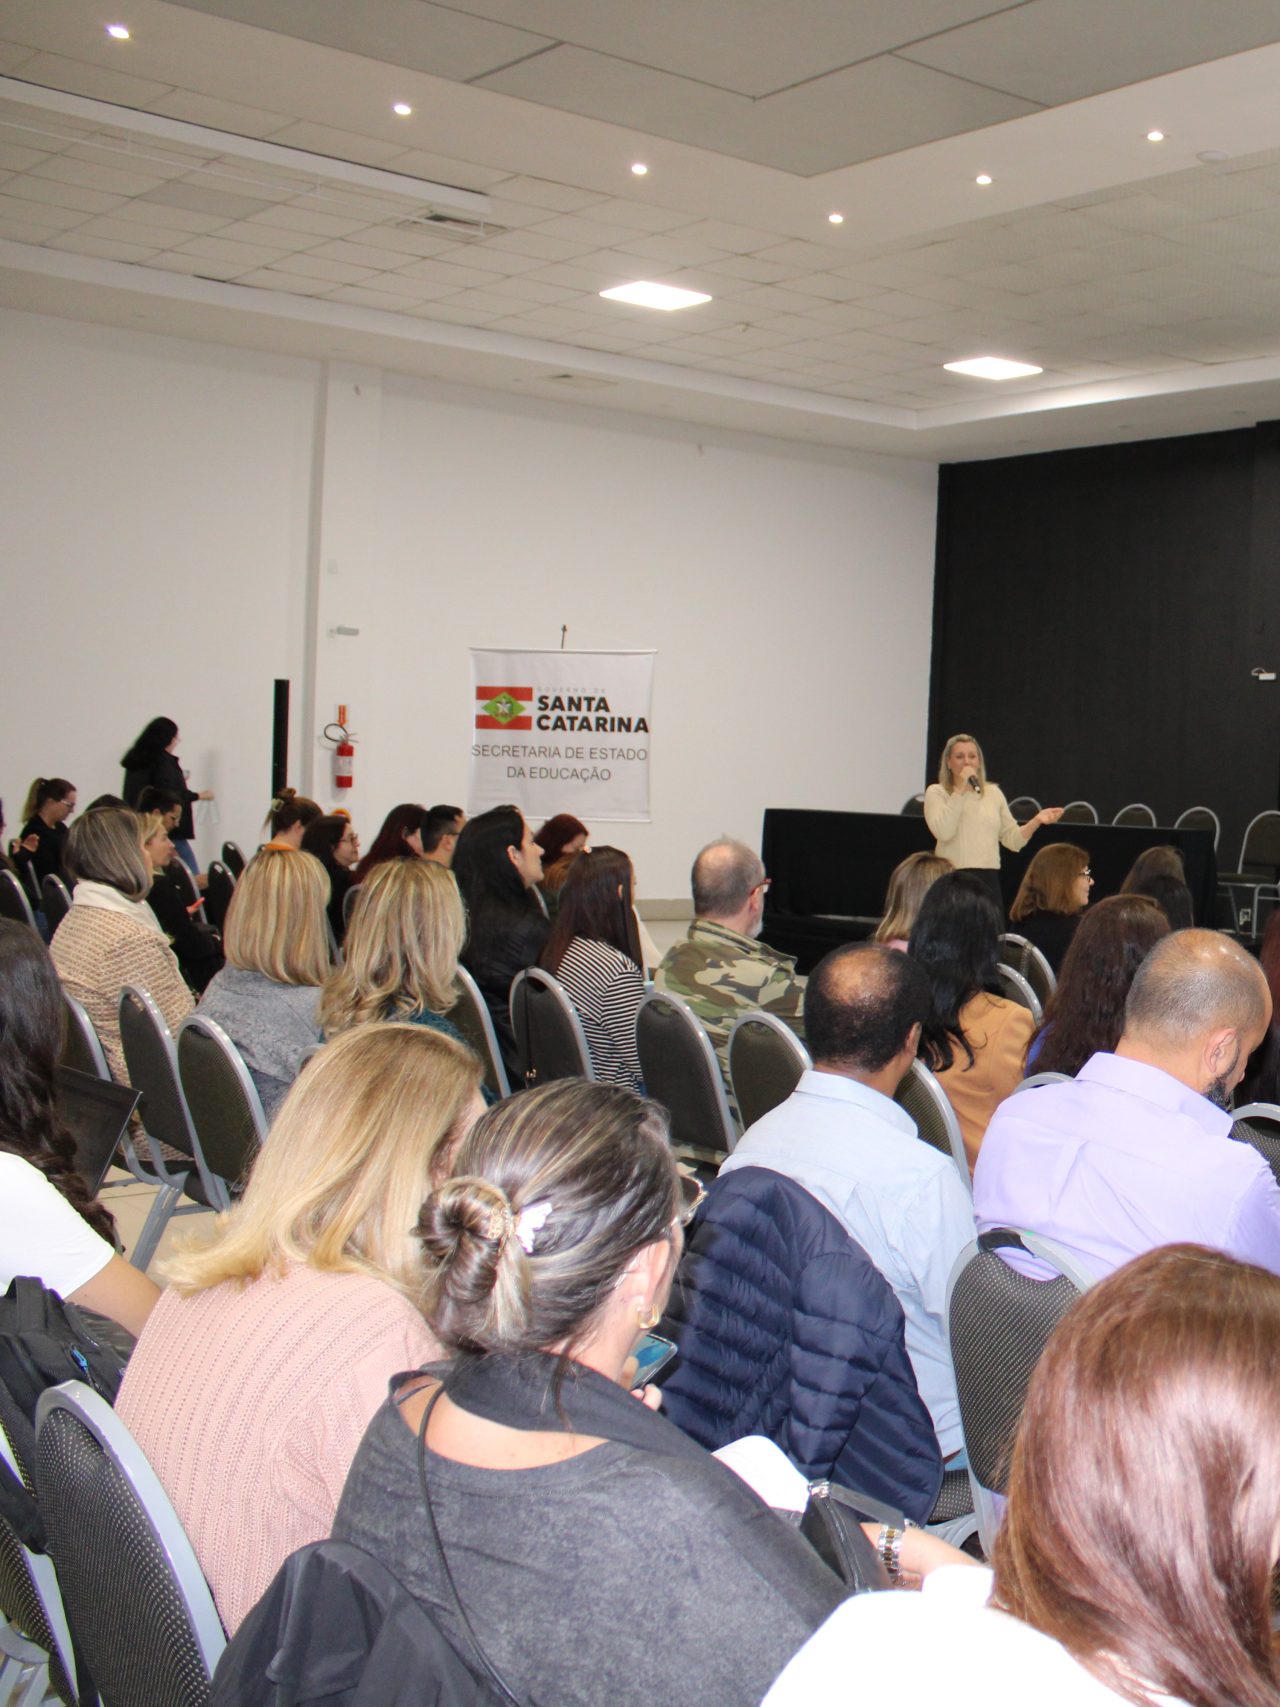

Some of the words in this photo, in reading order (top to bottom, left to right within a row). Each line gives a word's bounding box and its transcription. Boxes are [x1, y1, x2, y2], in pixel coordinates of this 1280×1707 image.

[537, 686, 587, 694] GOVERNO
[537, 695, 611, 713] SANTA
[536, 714, 650, 734] CATARINA
[471, 744, 561, 760] SECRETARIA
[565, 746, 585, 760] DE
[589, 747, 648, 761] ESTADO
[506, 766, 526, 779] DA
[529, 765, 612, 783] EDUCAÇÃO
